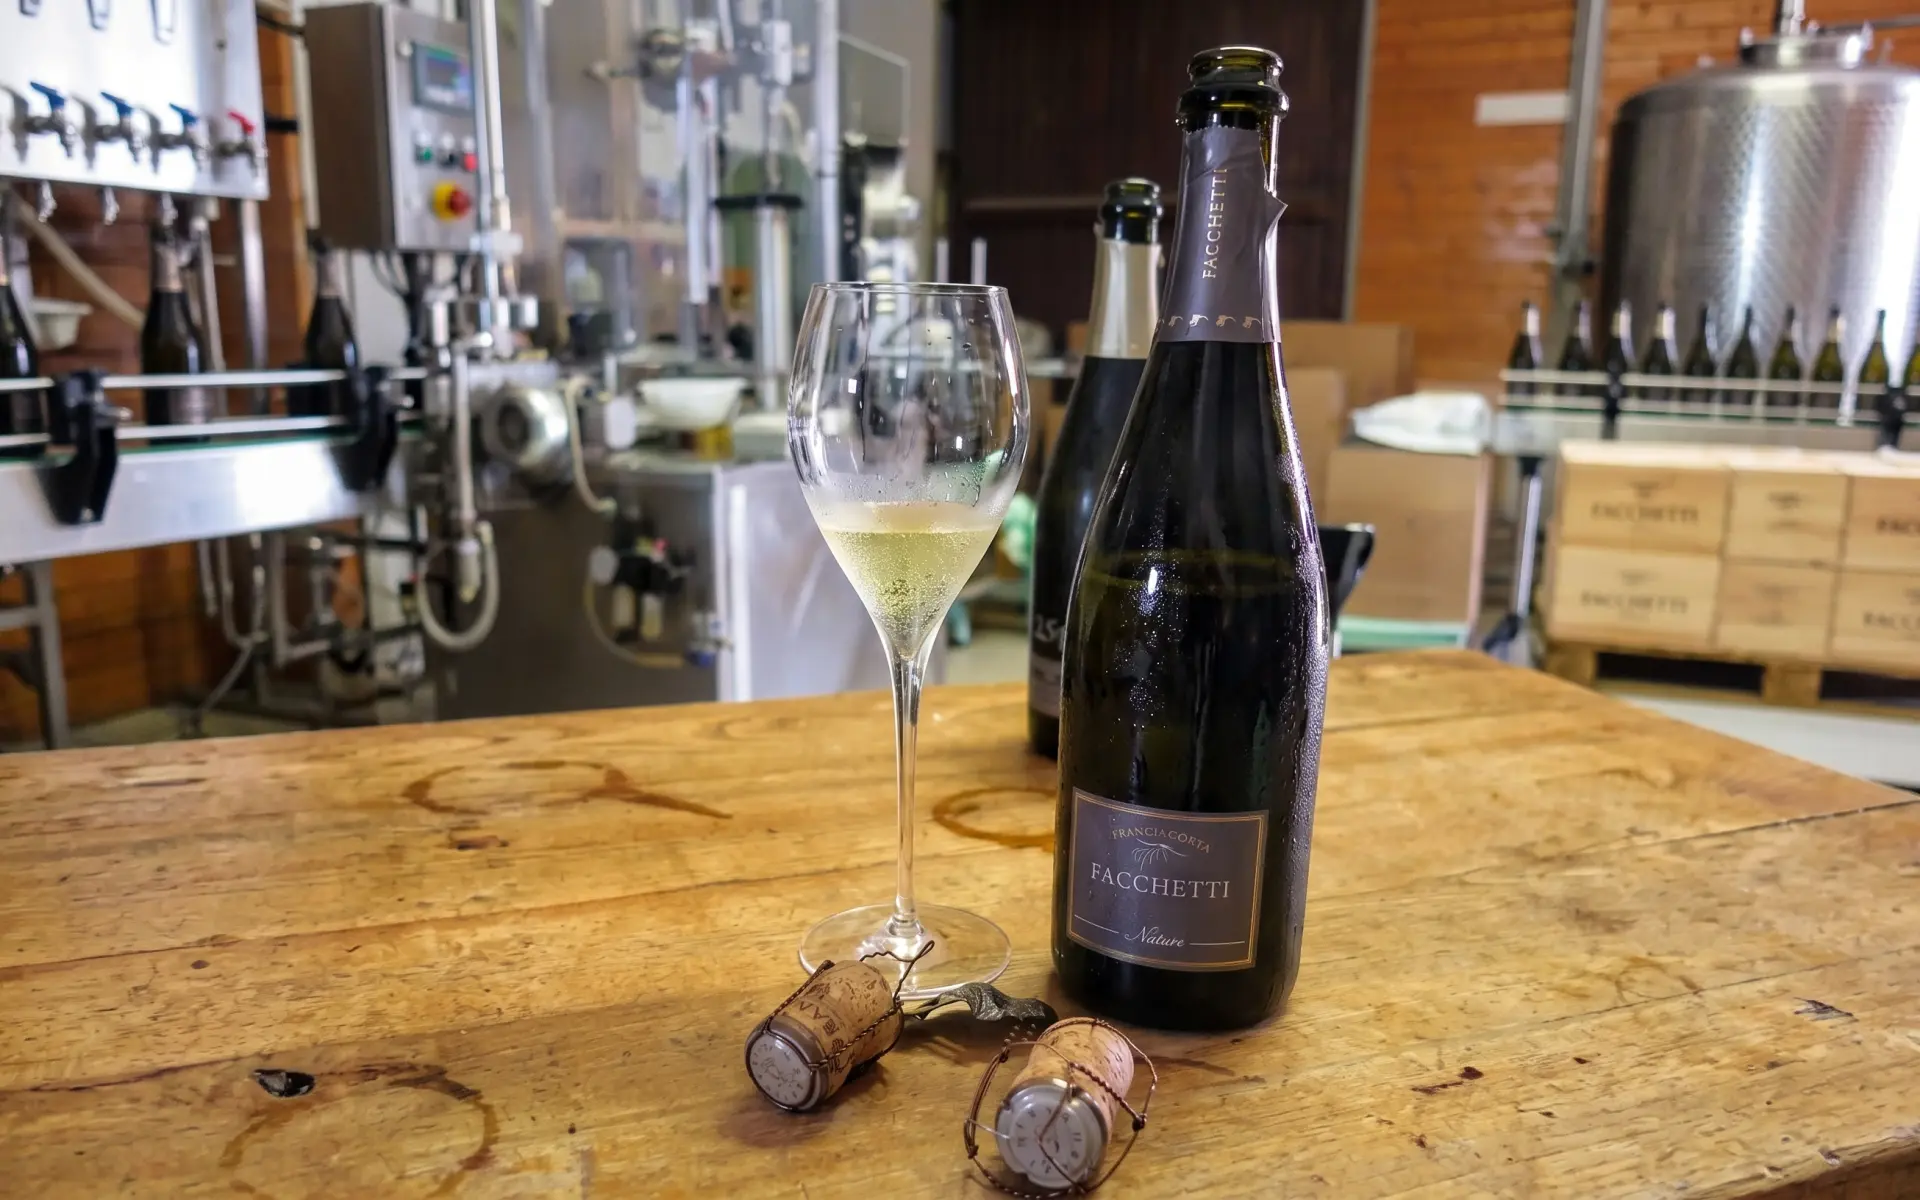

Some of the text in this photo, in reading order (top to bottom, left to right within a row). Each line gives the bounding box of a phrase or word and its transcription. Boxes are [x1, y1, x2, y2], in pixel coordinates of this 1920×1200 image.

[1202, 168, 1228, 279] FACCHETTI
[1112, 827, 1210, 854] FRANCIACORTA
[1091, 862, 1230, 899] FACCHETTI
[1124, 926, 1185, 948] Nature
